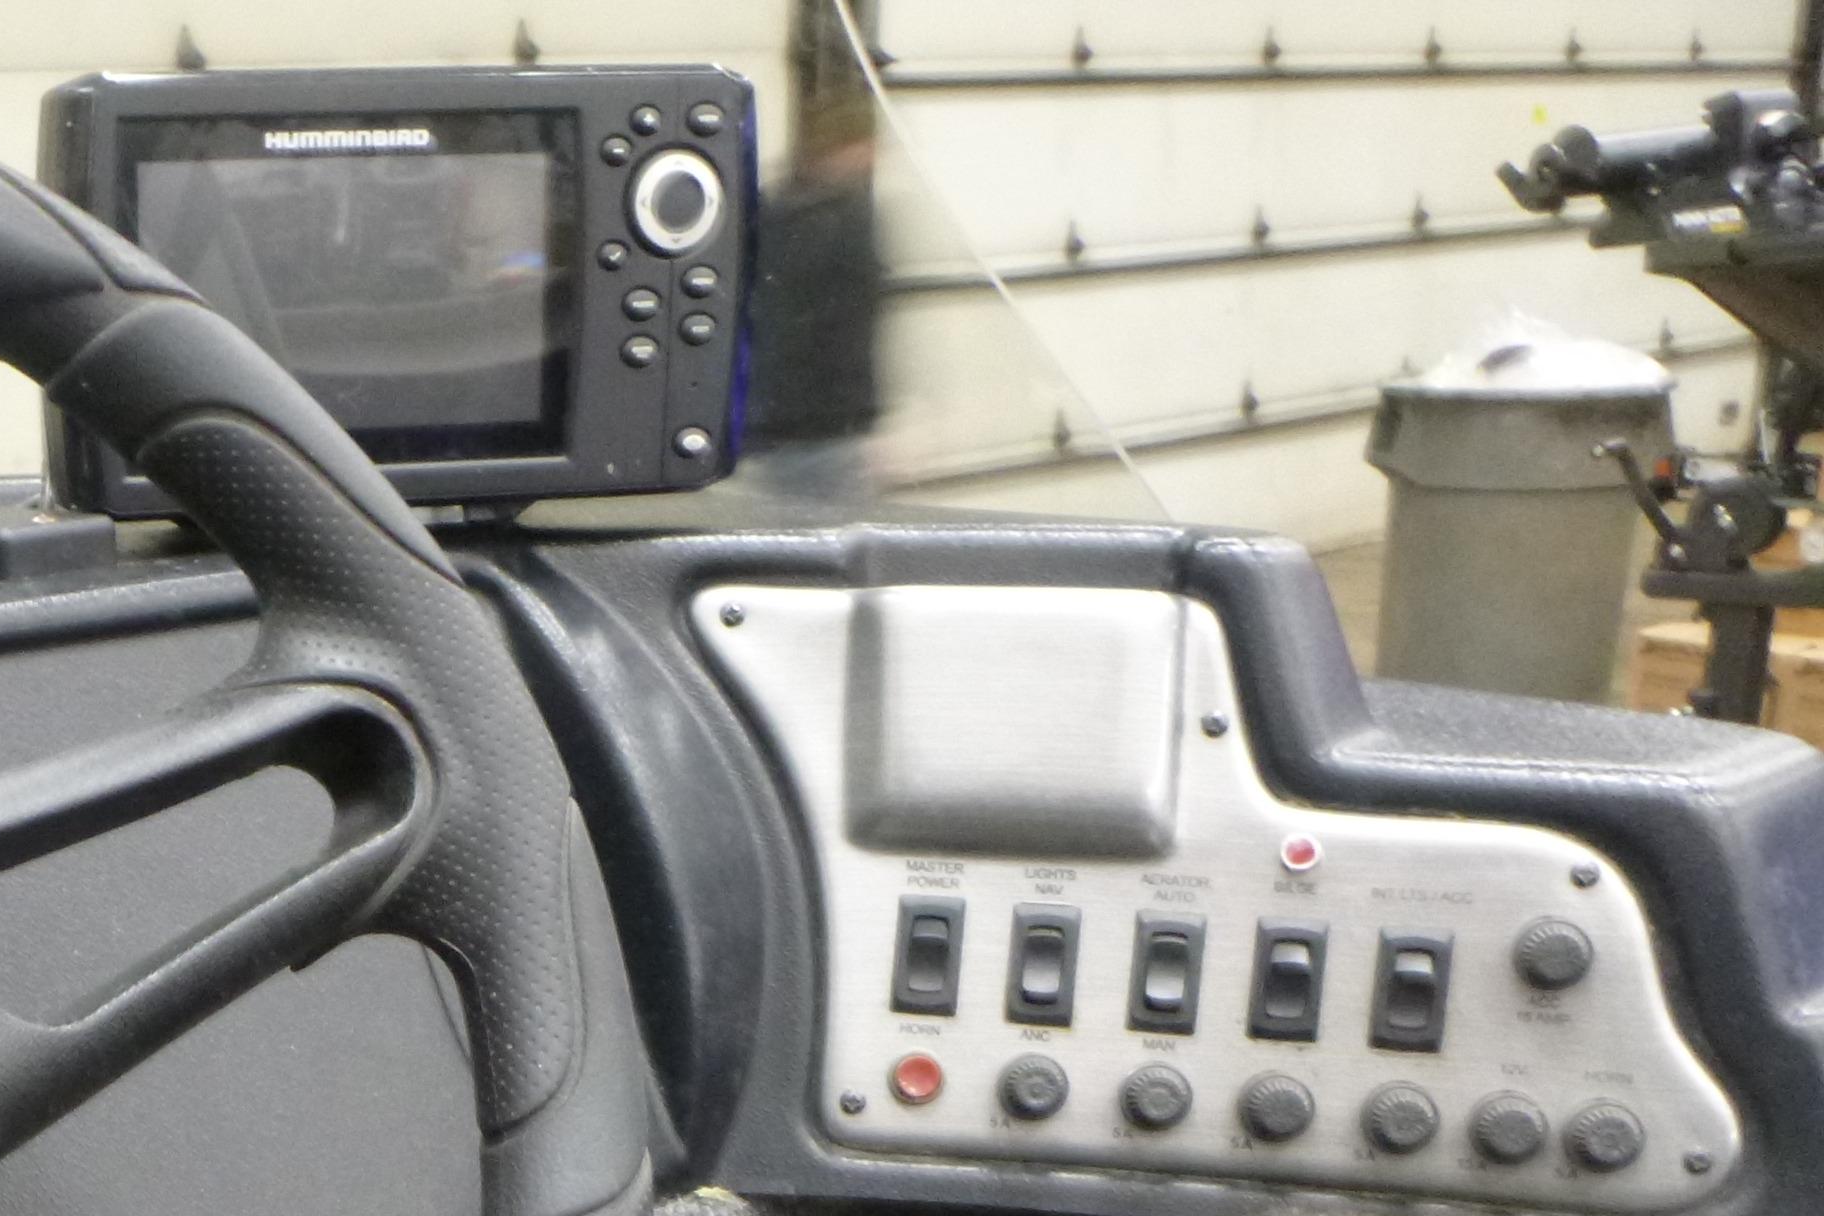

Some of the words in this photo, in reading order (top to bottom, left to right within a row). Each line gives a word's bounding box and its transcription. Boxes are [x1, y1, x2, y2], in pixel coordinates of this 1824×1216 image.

[264, 128, 430, 149] HUMMINBIRD
[905, 860, 965, 874] MASTER
[1024, 868, 1076, 881] LIGHTS
[907, 875, 960, 889] POWER
[1035, 883, 1063, 896] NAV
[1153, 889, 1195, 903] AUTO
[898, 1023, 942, 1037] HORN
[1019, 1029, 1050, 1042] ANC
[1141, 1038, 1175, 1051] MAN
